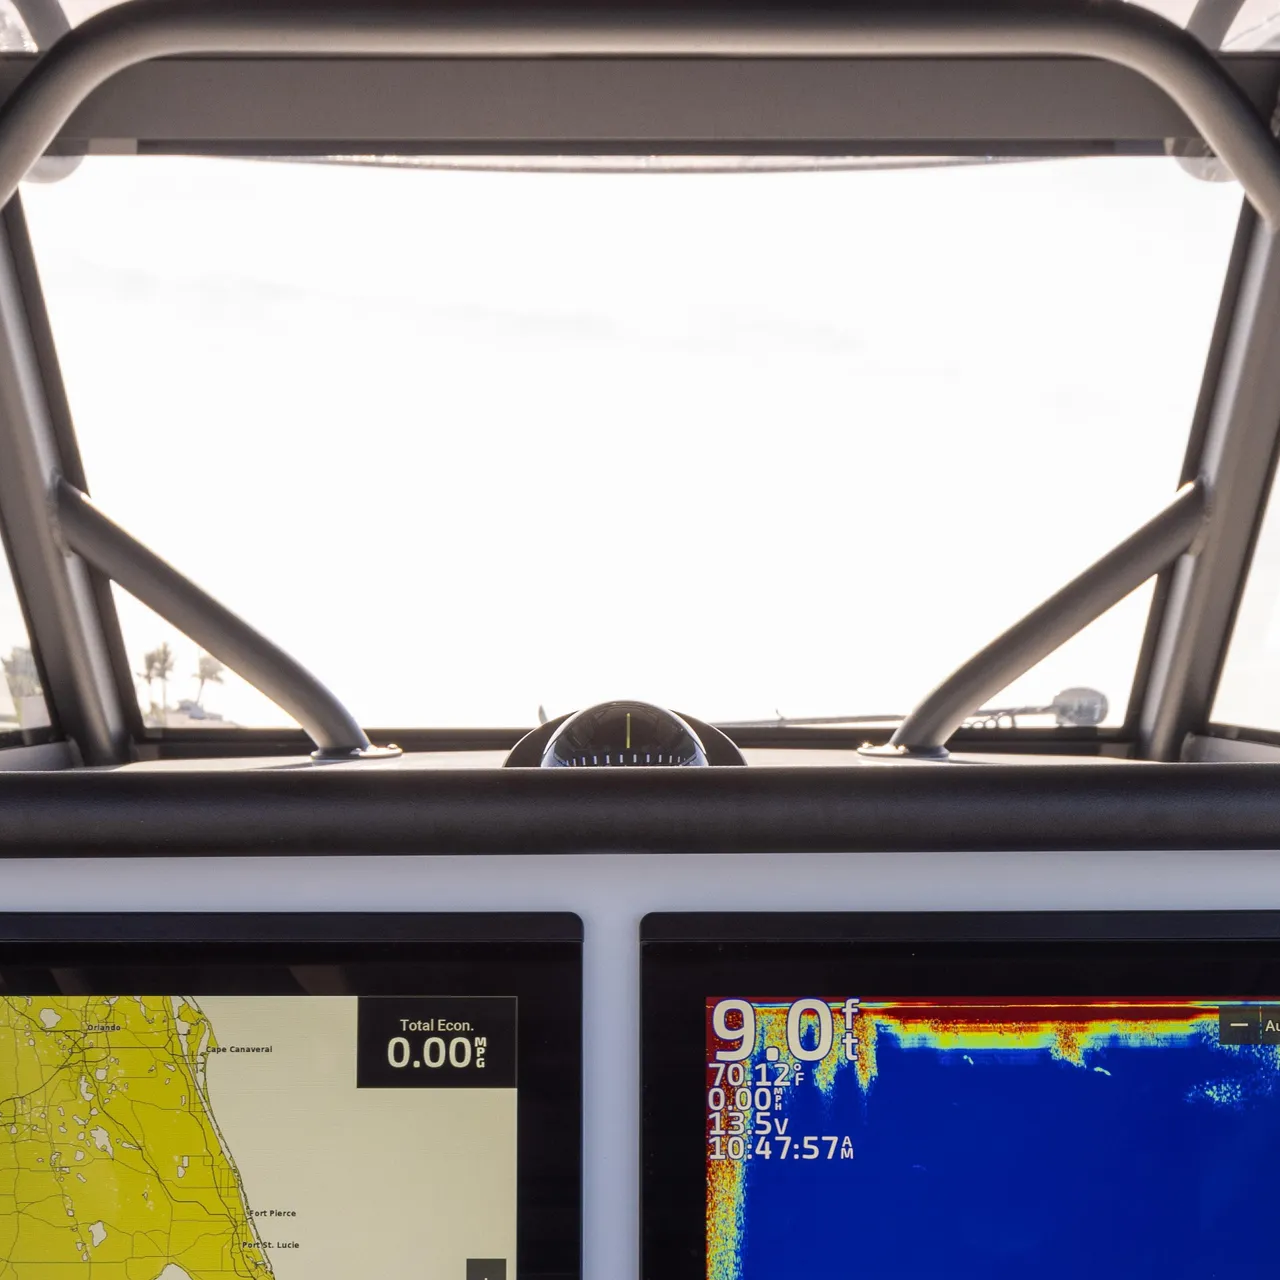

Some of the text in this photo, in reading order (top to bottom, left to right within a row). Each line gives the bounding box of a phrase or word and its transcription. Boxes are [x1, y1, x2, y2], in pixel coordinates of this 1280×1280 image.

[87, 1024, 121, 1032] Orlando
[400, 1019, 474, 1032] Total Econ.
[712, 998, 833, 1062] 9.0
[206, 1045, 273, 1054] Cape Canaveral
[387, 1037, 472, 1068] 0.00
[708, 1063, 791, 1086] 70.12
[708, 1087, 772, 1111] 0.00
[708, 1136, 839, 1159] 10:47:57
[242, 1241, 300, 1249] Port St. Lucie
